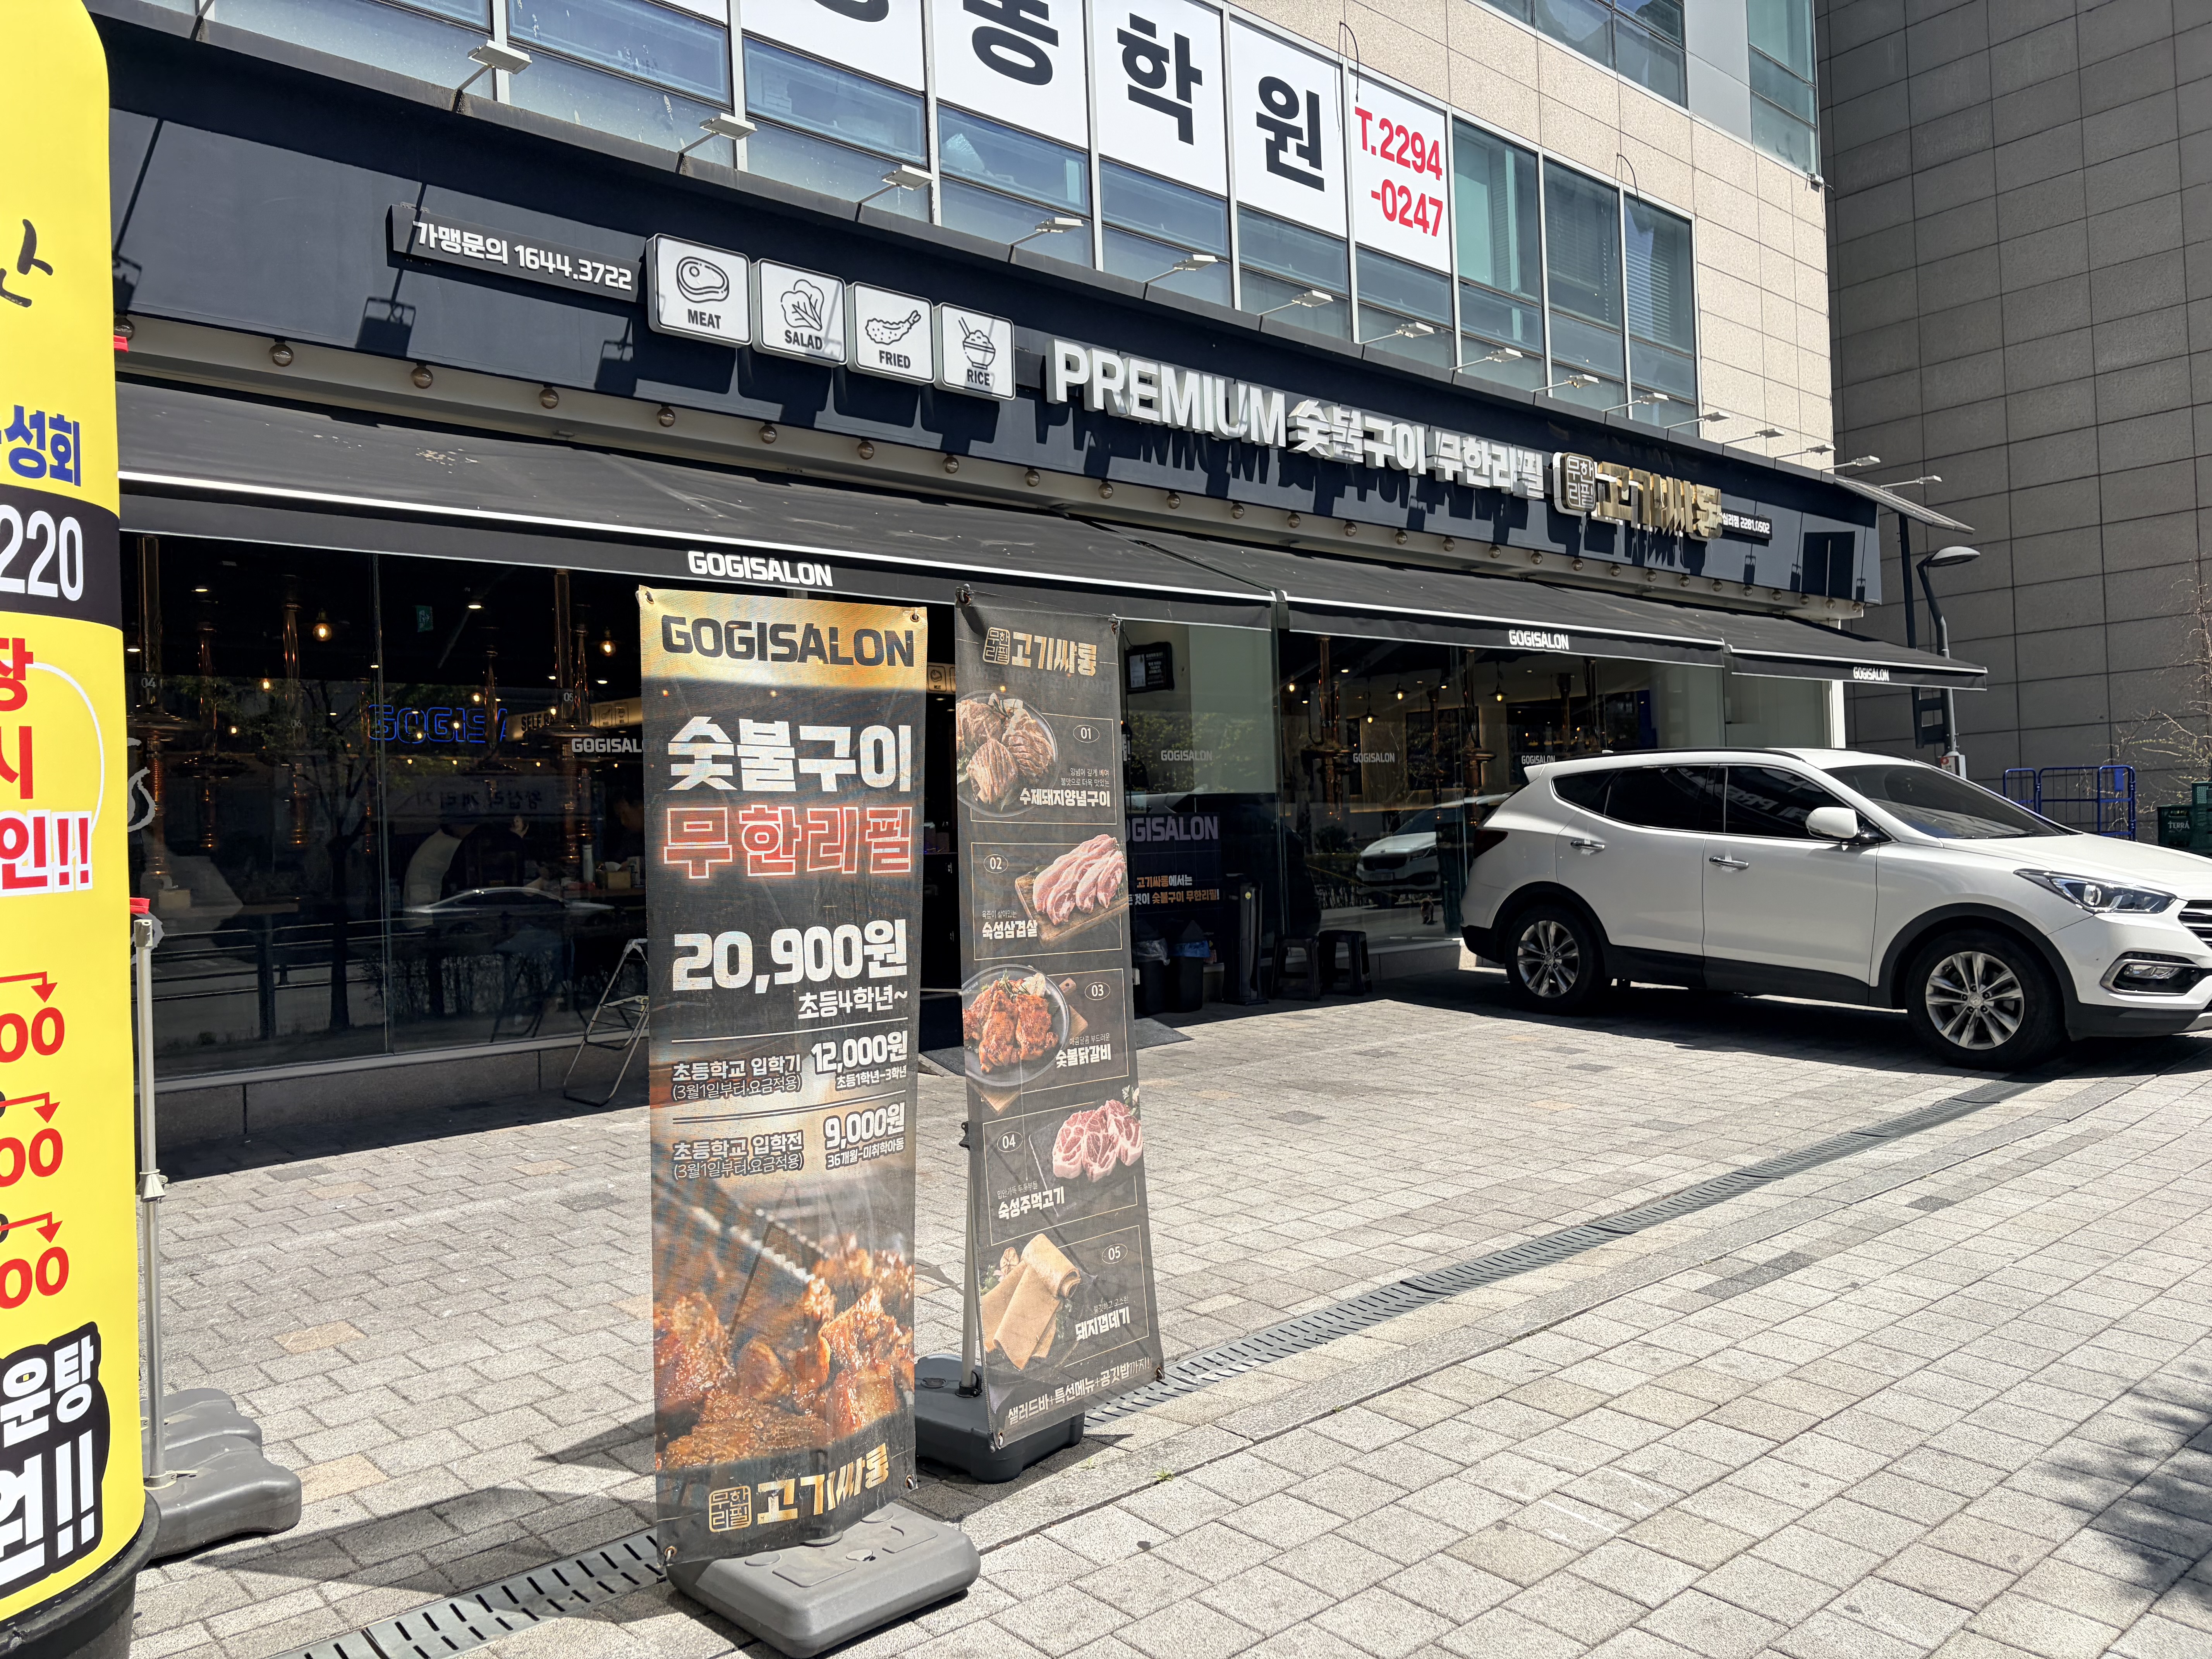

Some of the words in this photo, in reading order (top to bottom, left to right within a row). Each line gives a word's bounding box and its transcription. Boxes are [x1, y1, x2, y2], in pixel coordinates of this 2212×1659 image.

[1355, 106, 1443, 181] T.2294
[1371, 180, 1444, 237] -0247
[413, 220, 508, 264] 가맹문의
[514, 245, 632, 291] 1644.3722
[687, 309, 721, 330] MEAT
[785, 330, 823, 350] SALAD
[879, 350, 911, 369] FRIED
[967, 369, 990, 386] RICE
[1047, 338, 1286, 448] PREMIUM
[1288, 400, 1426, 475] 숯불구이
[1433, 430, 1544, 500] 무한리필
[0, 405, 81, 487] 성회
[1566, 459, 1594, 484] 무한
[1567, 483, 1594, 508] 리필
[1717, 512, 1739, 528] 십리점
[688, 550, 833, 587] GOGISALON
[661, 614, 914, 667] GOGISALON
[987, 630, 1009, 646] 무한
[1509, 629, 1569, 650] GOGISALON
[986, 646, 1009, 663] 리필
[1853, 666, 1889, 682] GOGISALON
[1080, 727, 1091, 739] 01
[572, 737, 644, 753] GOGISAL
[668, 716, 911, 792] 숯불구이
[1161, 750, 1212, 761] GOGISALON
[1353, 752, 1395, 763] GOGISALON
[1522, 755, 1556, 765] GOGISALON
[1070, 768, 1085, 776] 양념이
[1061, 778, 1081, 786] 불맛으로
[1082, 778, 1093, 787] 더욱
[1094, 779, 1110, 787] 맛있는
[1020, 788, 1110, 807] 수제돼지양념구이
[2168, 821, 2190, 829] TERRA
[664, 804, 913, 879] 무한리필
[989, 858, 1002, 870] 02
[1152, 891, 1184, 904] 숯불구이
[982, 910, 996, 919] 육즙이
[998, 909, 1018, 919] 살아있는
[982, 920, 1038, 940] 숙성삼겹살
[673, 919, 907, 994] 20,900원
[1091, 984, 1104, 997] 03
[1069, 1035, 1089, 1046] 매콤달콤
[1091, 1032, 1110, 1043] 부드러운
[811, 1030, 908, 1073] 12,000원
[1056, 1043, 1111, 1068] 숯불닭갈비
[673, 1060, 746, 1081] 초등학교
[751, 1054, 800, 1076] 입학기
[836, 1065, 907, 1089] 초등1학년-3학년
[825, 1102, 905, 1149] 9,000원
[673, 1139, 747, 1160] 초등학교
[752, 1132, 802, 1155] 입학전
[1002, 1134, 1016, 1149] 04
[997, 1186, 1017, 1200] 입안가득
[998, 1186, 1065, 1220] 숙성주먹고기
[1108, 1246, 1121, 1260] 05
[1114, 1295, 1129, 1307] 고소한
[1075, 1306, 1130, 1341] 돼지껍데기
[711, 1489, 749, 1508] 무한
[711, 1505, 749, 1526] 리필
